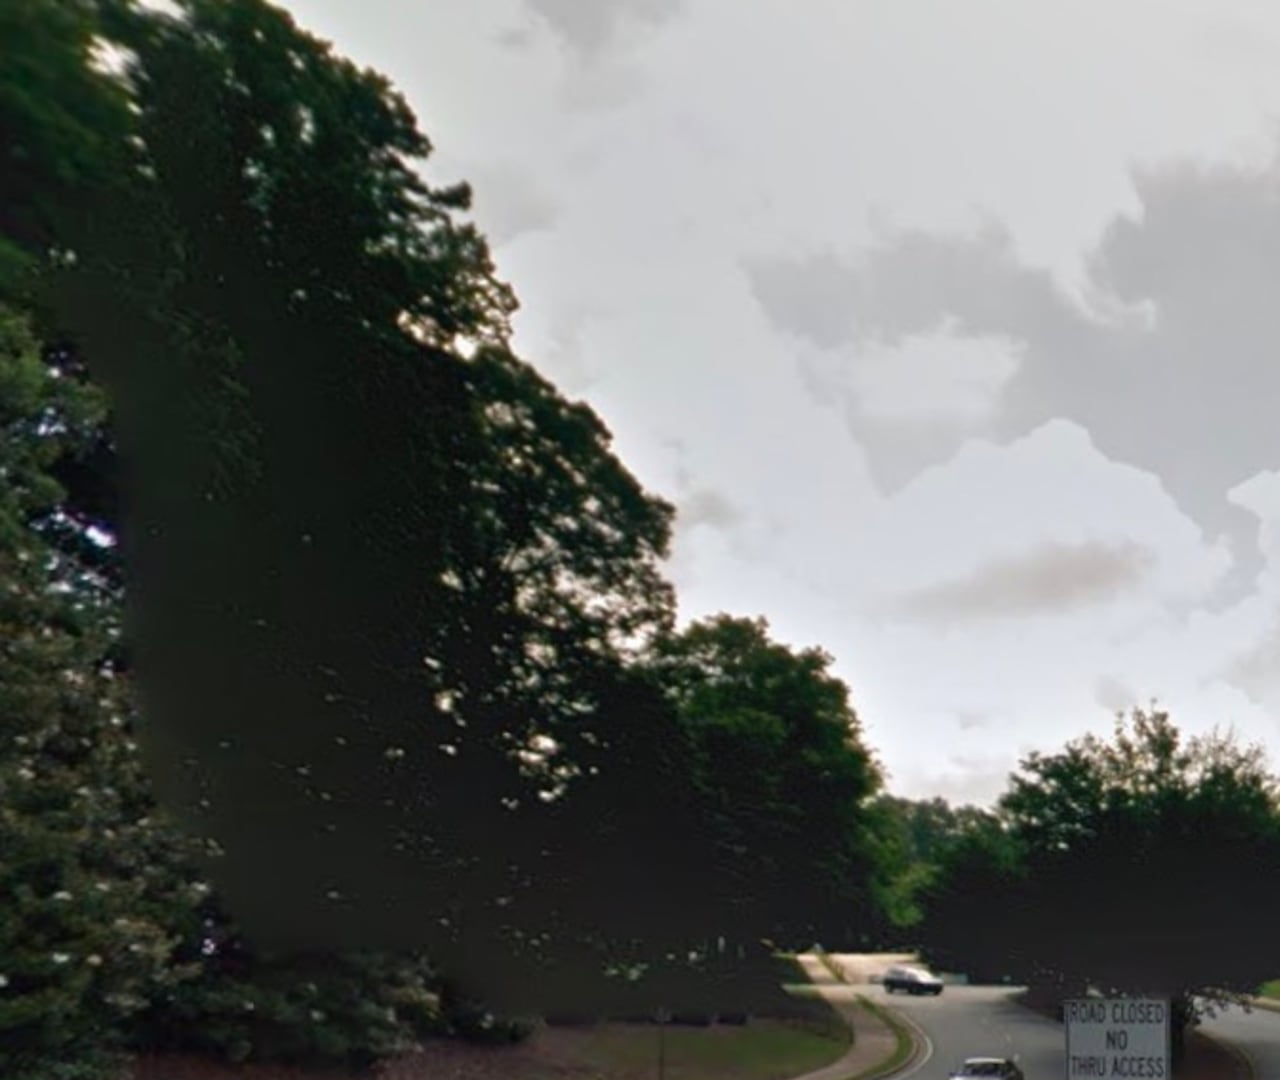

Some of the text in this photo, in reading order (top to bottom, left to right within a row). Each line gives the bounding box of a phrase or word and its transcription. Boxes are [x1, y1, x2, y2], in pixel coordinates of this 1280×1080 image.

[1070, 1003, 1164, 1024] ROAD CLOSED
[1106, 1030, 1128, 1050] NO
[1072, 1056, 1164, 1077] THRU ACCESS
